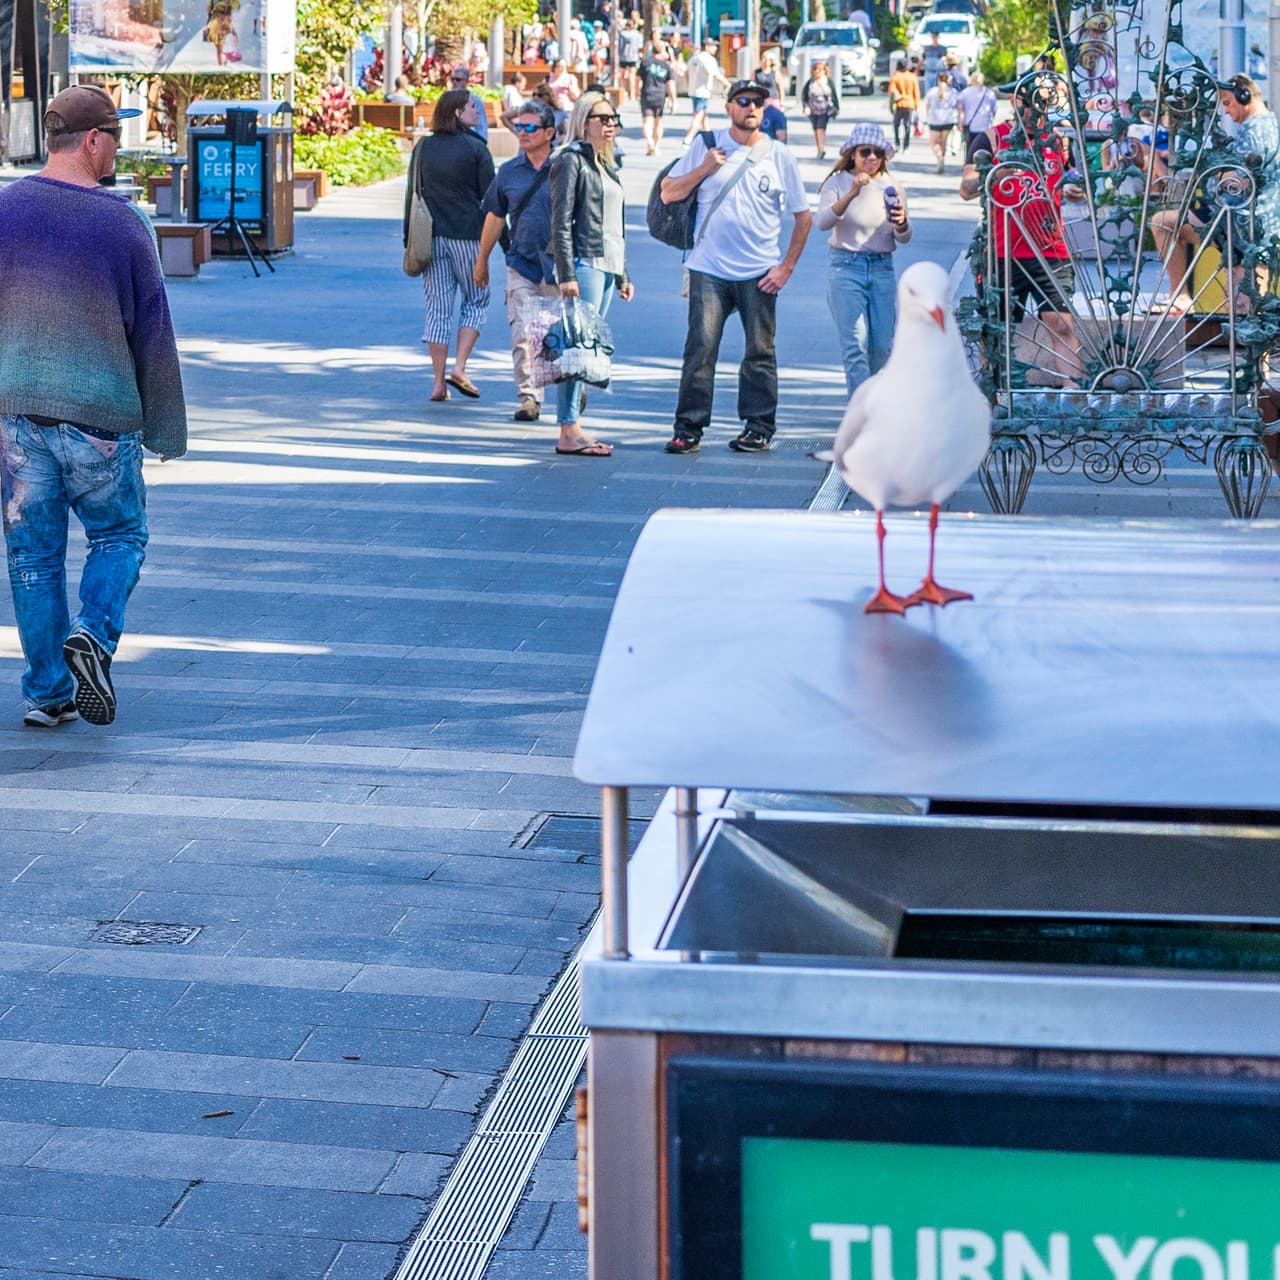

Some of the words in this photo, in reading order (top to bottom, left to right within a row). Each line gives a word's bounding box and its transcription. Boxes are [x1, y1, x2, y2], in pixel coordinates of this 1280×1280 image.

[203, 162, 258, 177] FERRY
[810, 1223, 1069, 1280] TURN
[1093, 1234, 1280, 1280] YOU
